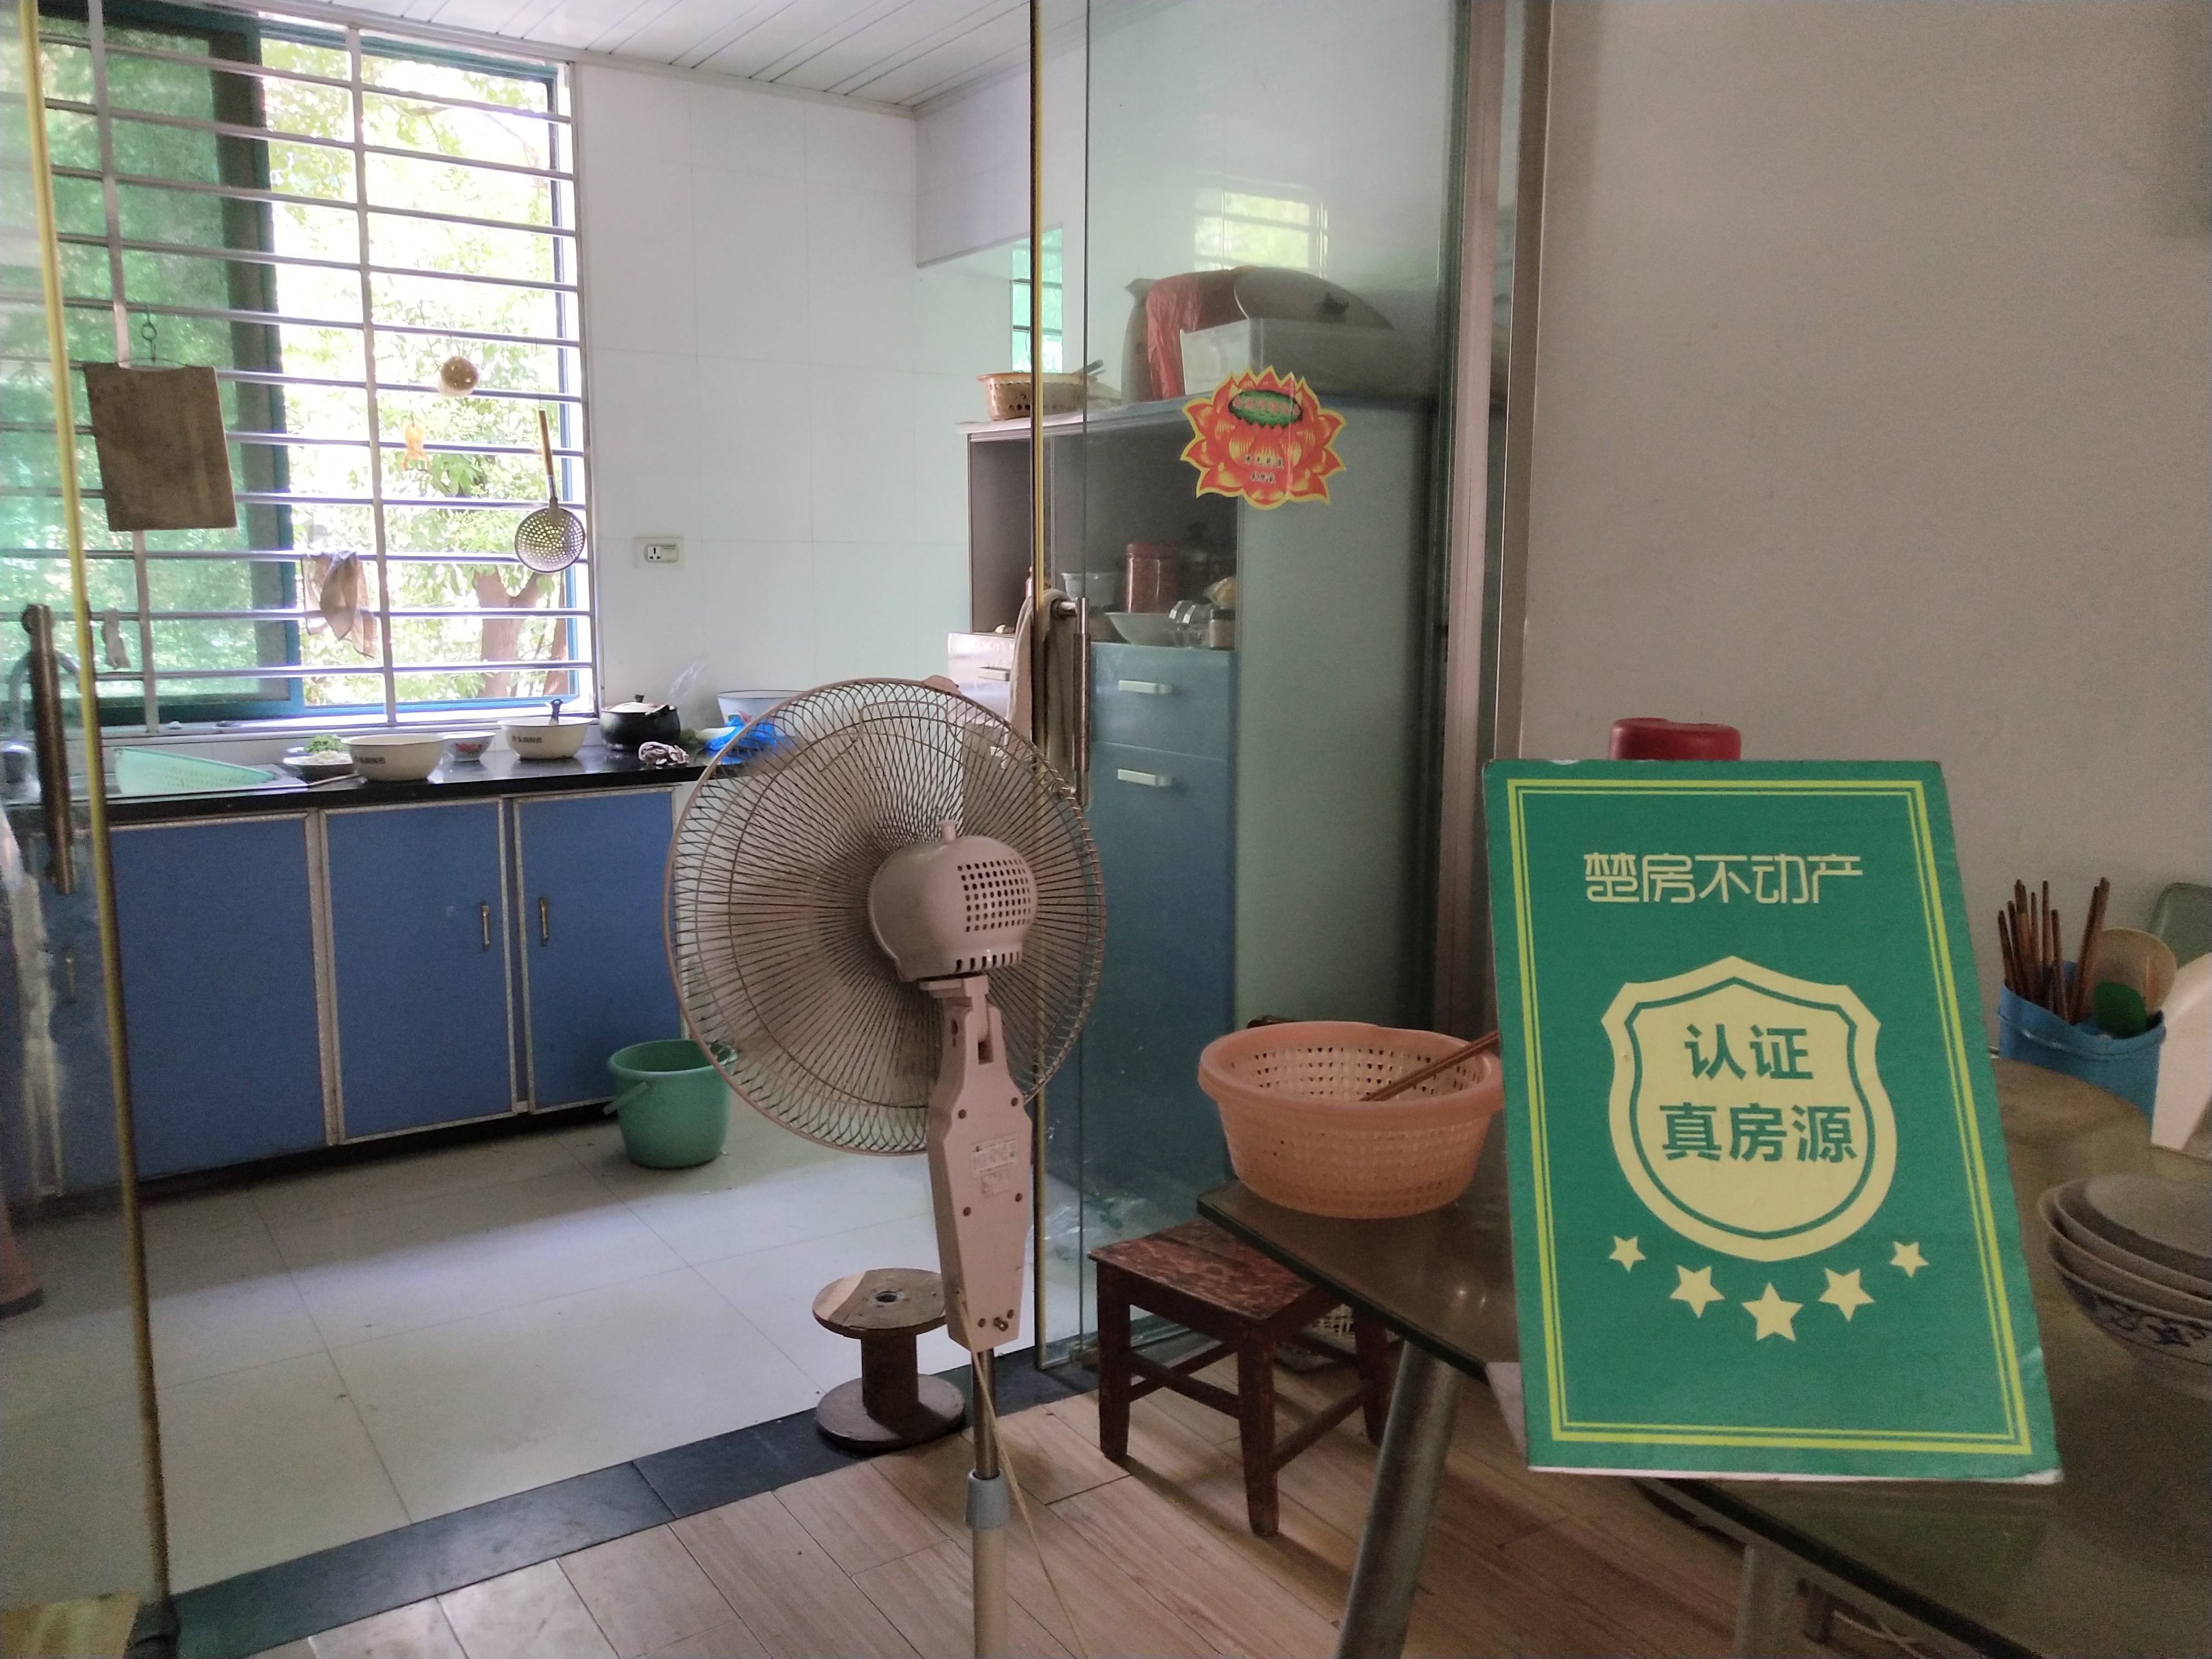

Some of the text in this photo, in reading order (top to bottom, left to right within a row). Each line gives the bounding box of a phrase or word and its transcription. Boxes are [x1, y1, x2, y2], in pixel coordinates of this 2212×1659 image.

[1584, 853, 1863, 904] 楚房不动产
[1684, 1024, 1814, 1080] 认证
[1660, 1102, 1857, 1163] 真房源
